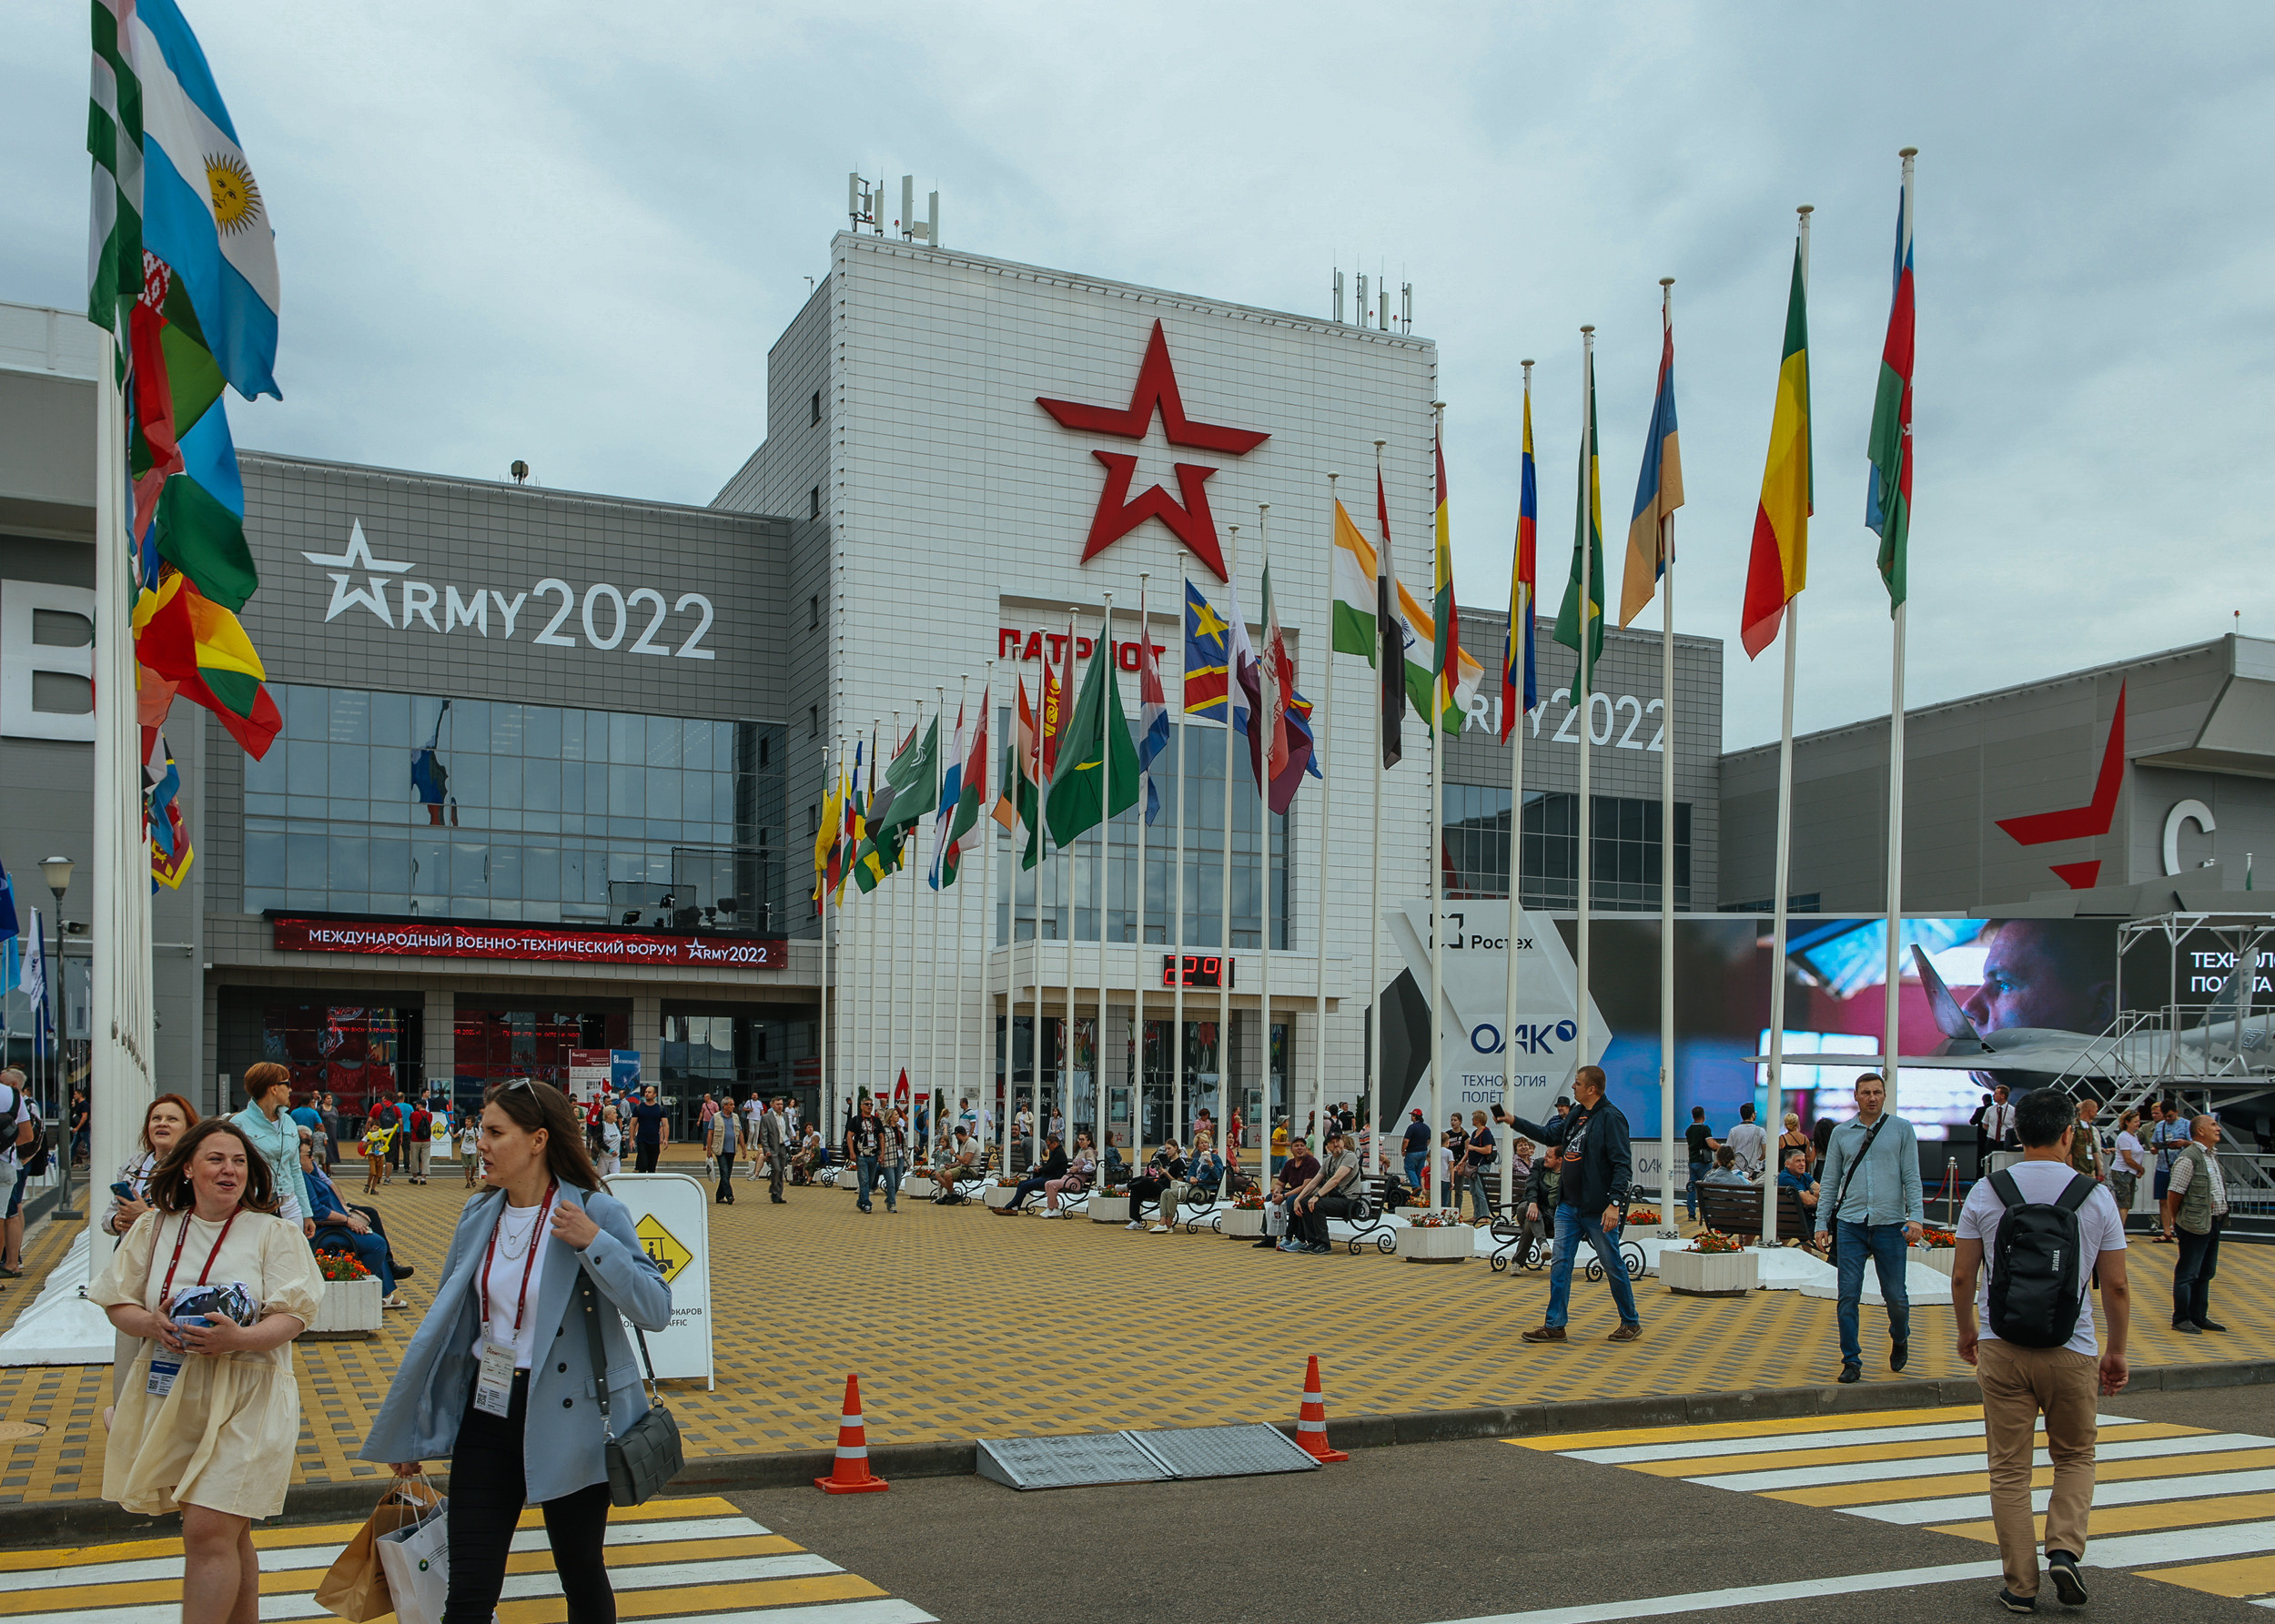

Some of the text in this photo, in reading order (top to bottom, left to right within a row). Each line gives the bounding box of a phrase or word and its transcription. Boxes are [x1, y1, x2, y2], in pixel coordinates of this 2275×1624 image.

[999, 628, 1166, 671] ПАТРОТ
[308, 929, 452, 948] МЕЖДУНАРОДНЫЙ
[455, 935, 624, 955] ВОЕННО-ТЕХНИЧЕСКИЙ
[626, 943, 677, 956] ФОРУМ
[2190, 976, 2273, 993] ПОТА
[1461, 1074, 1546, 1087] ТЕХНООГИЯ
[1461, 1089, 1504, 1104] ПОЛЁТ
[2051, 1249, 2060, 1272] THULE
